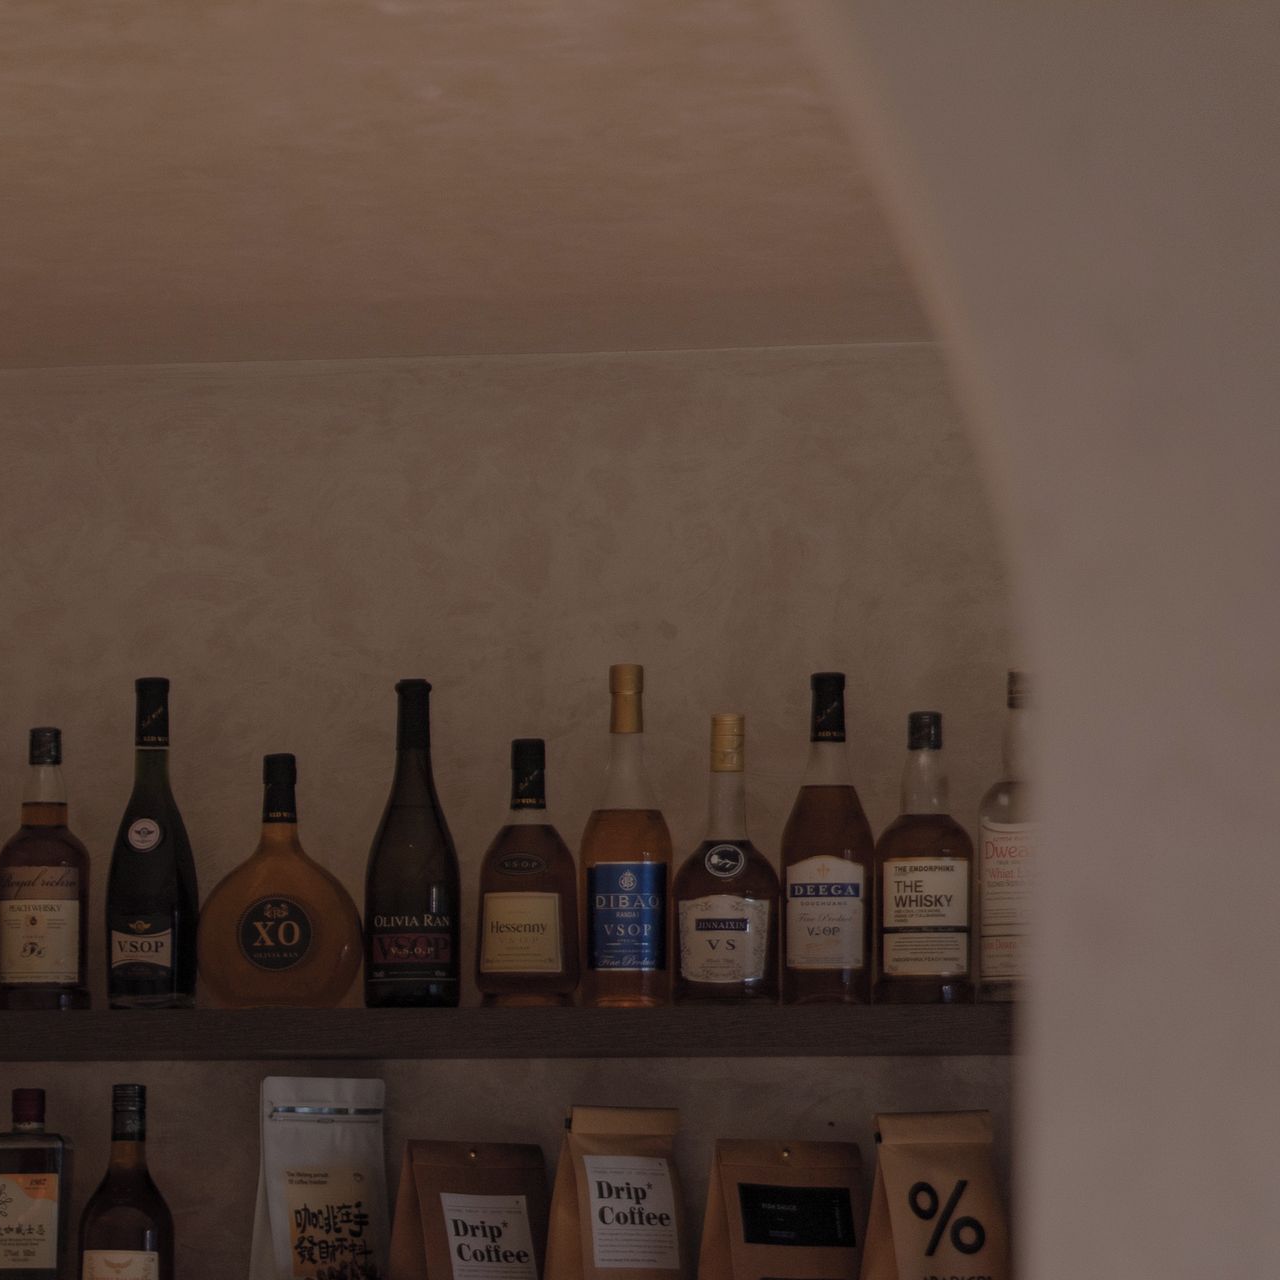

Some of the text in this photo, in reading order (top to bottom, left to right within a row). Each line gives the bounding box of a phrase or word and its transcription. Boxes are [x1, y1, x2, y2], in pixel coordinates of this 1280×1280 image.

[794, 885, 856, 896] DEEGA
[894, 880, 923, 893] THE
[595, 895, 660, 908] DIBAO
[894, 894, 953, 908] WHISKY
[374, 914, 450, 928] OLIVIA RAN
[490, 920, 547, 935] Hessenny
[252, 920, 300, 946] XO
[598, 1205, 672, 1227] Coffee
[456, 1243, 530, 1264] Coffee
